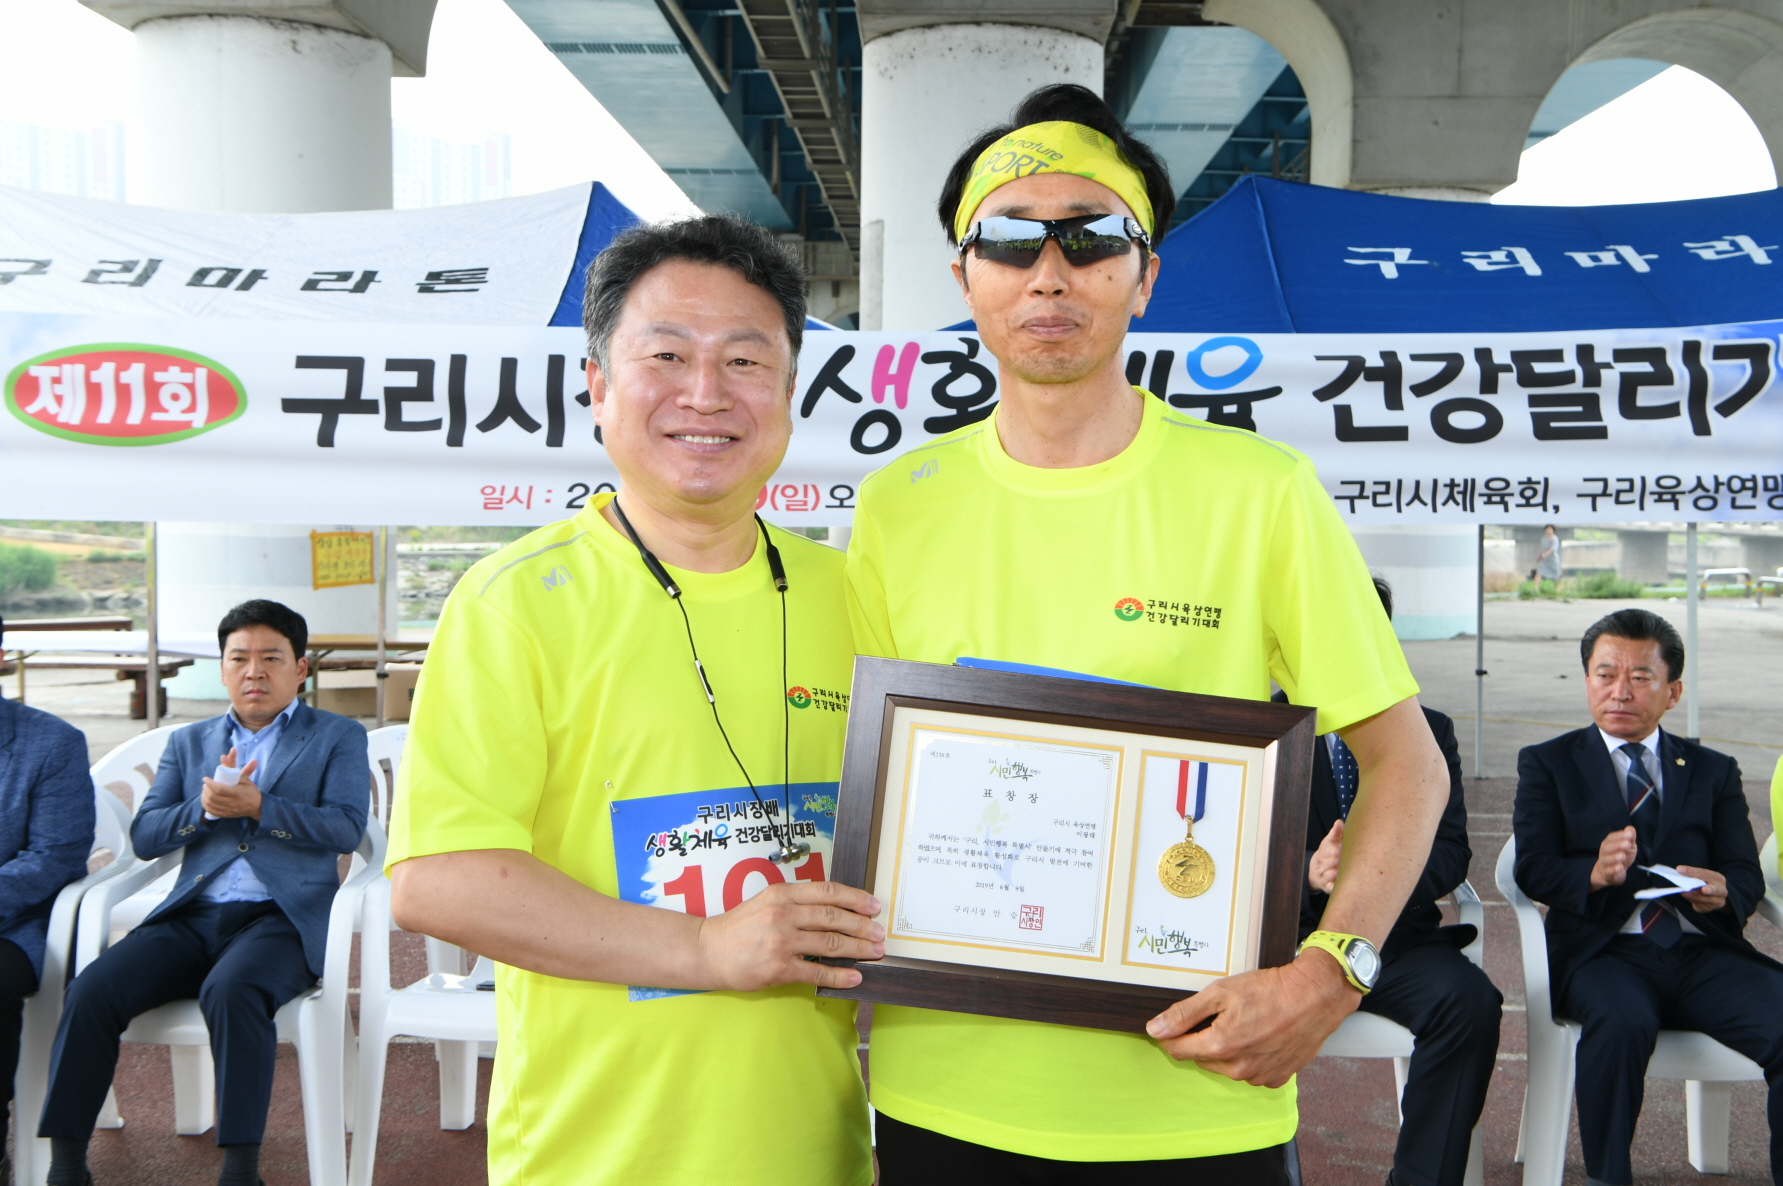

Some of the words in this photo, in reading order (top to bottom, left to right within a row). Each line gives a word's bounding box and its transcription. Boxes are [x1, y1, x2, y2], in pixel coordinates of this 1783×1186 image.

[1014, 139, 1064, 161] nature
[975, 151, 1050, 178] PORT
[25, 360, 209, 429] 제11회
[281, 353, 605, 448] 구리시
[1334, 477, 1560, 515] 구리시체육회,
[1146, 611, 1220, 630] 건강달리기대회
[990, 761, 1033, 781] 시민행복
[697, 799, 779, 824] 구리시장배
[646, 823, 731, 858] 생활체육
[1138, 929, 1198, 958] 시민행복
